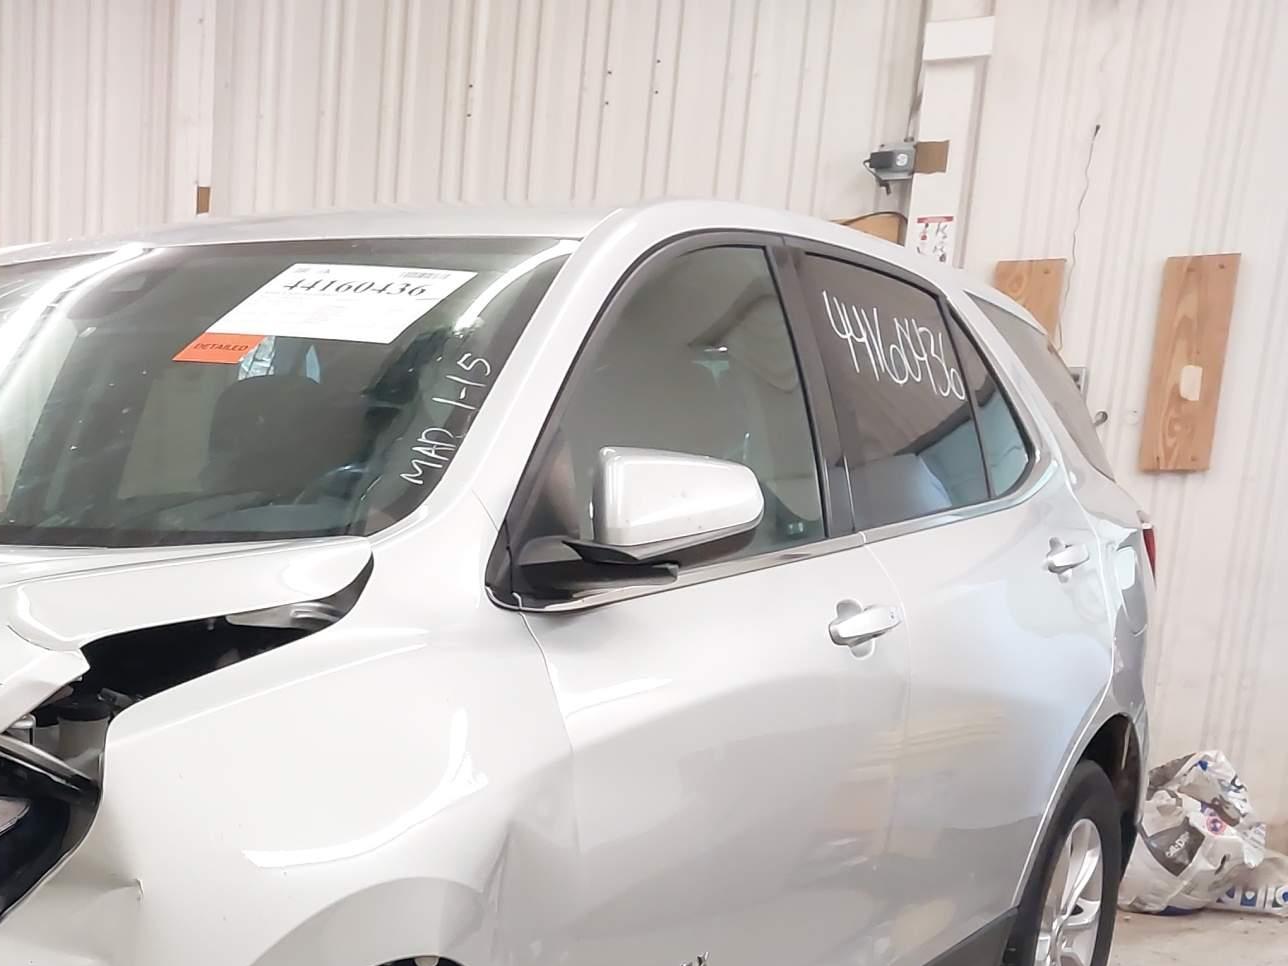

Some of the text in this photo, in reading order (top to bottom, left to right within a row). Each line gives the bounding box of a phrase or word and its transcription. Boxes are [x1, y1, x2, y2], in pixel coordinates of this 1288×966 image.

[284, 279, 431, 296] 44160436
[193, 343, 249, 352] DETAILED
[822, 289, 966, 400] 44160436
